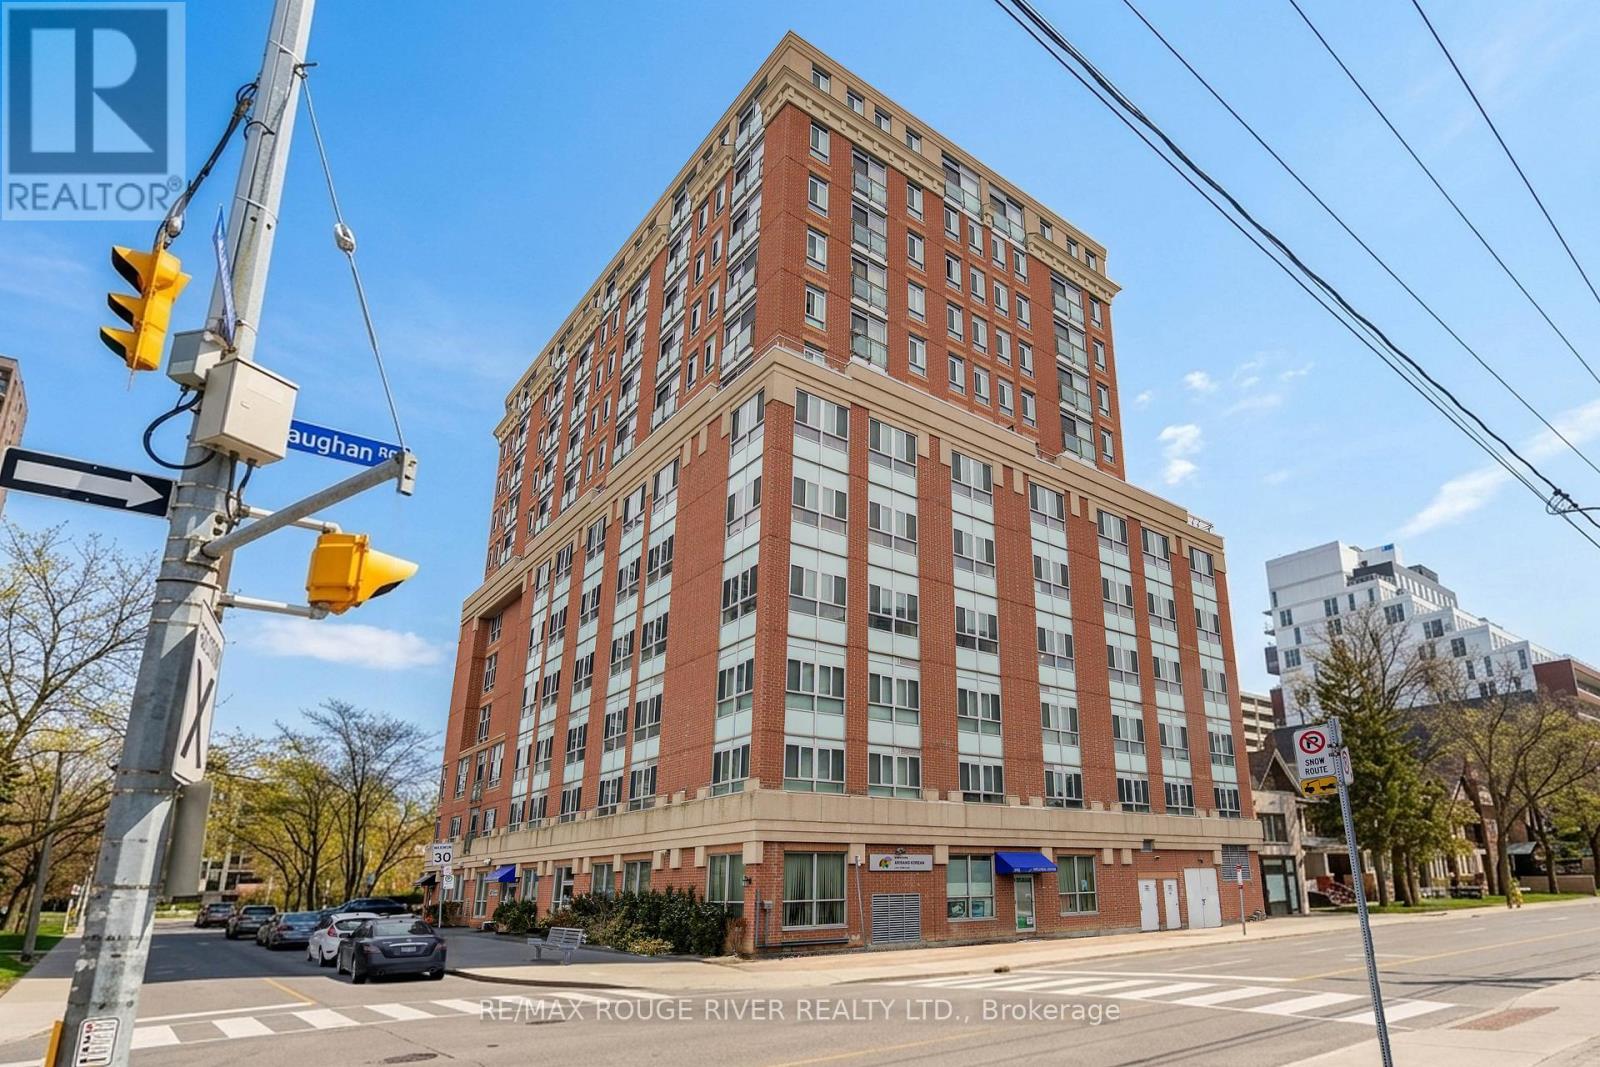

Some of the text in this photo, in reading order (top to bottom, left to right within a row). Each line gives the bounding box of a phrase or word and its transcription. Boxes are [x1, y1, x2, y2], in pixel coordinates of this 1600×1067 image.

[288, 428, 372, 461] aughan
[1305, 757, 1325, 767] SNOW
[1305, 766, 1328, 775] ROUTE
[434, 852, 451, 863] 30
